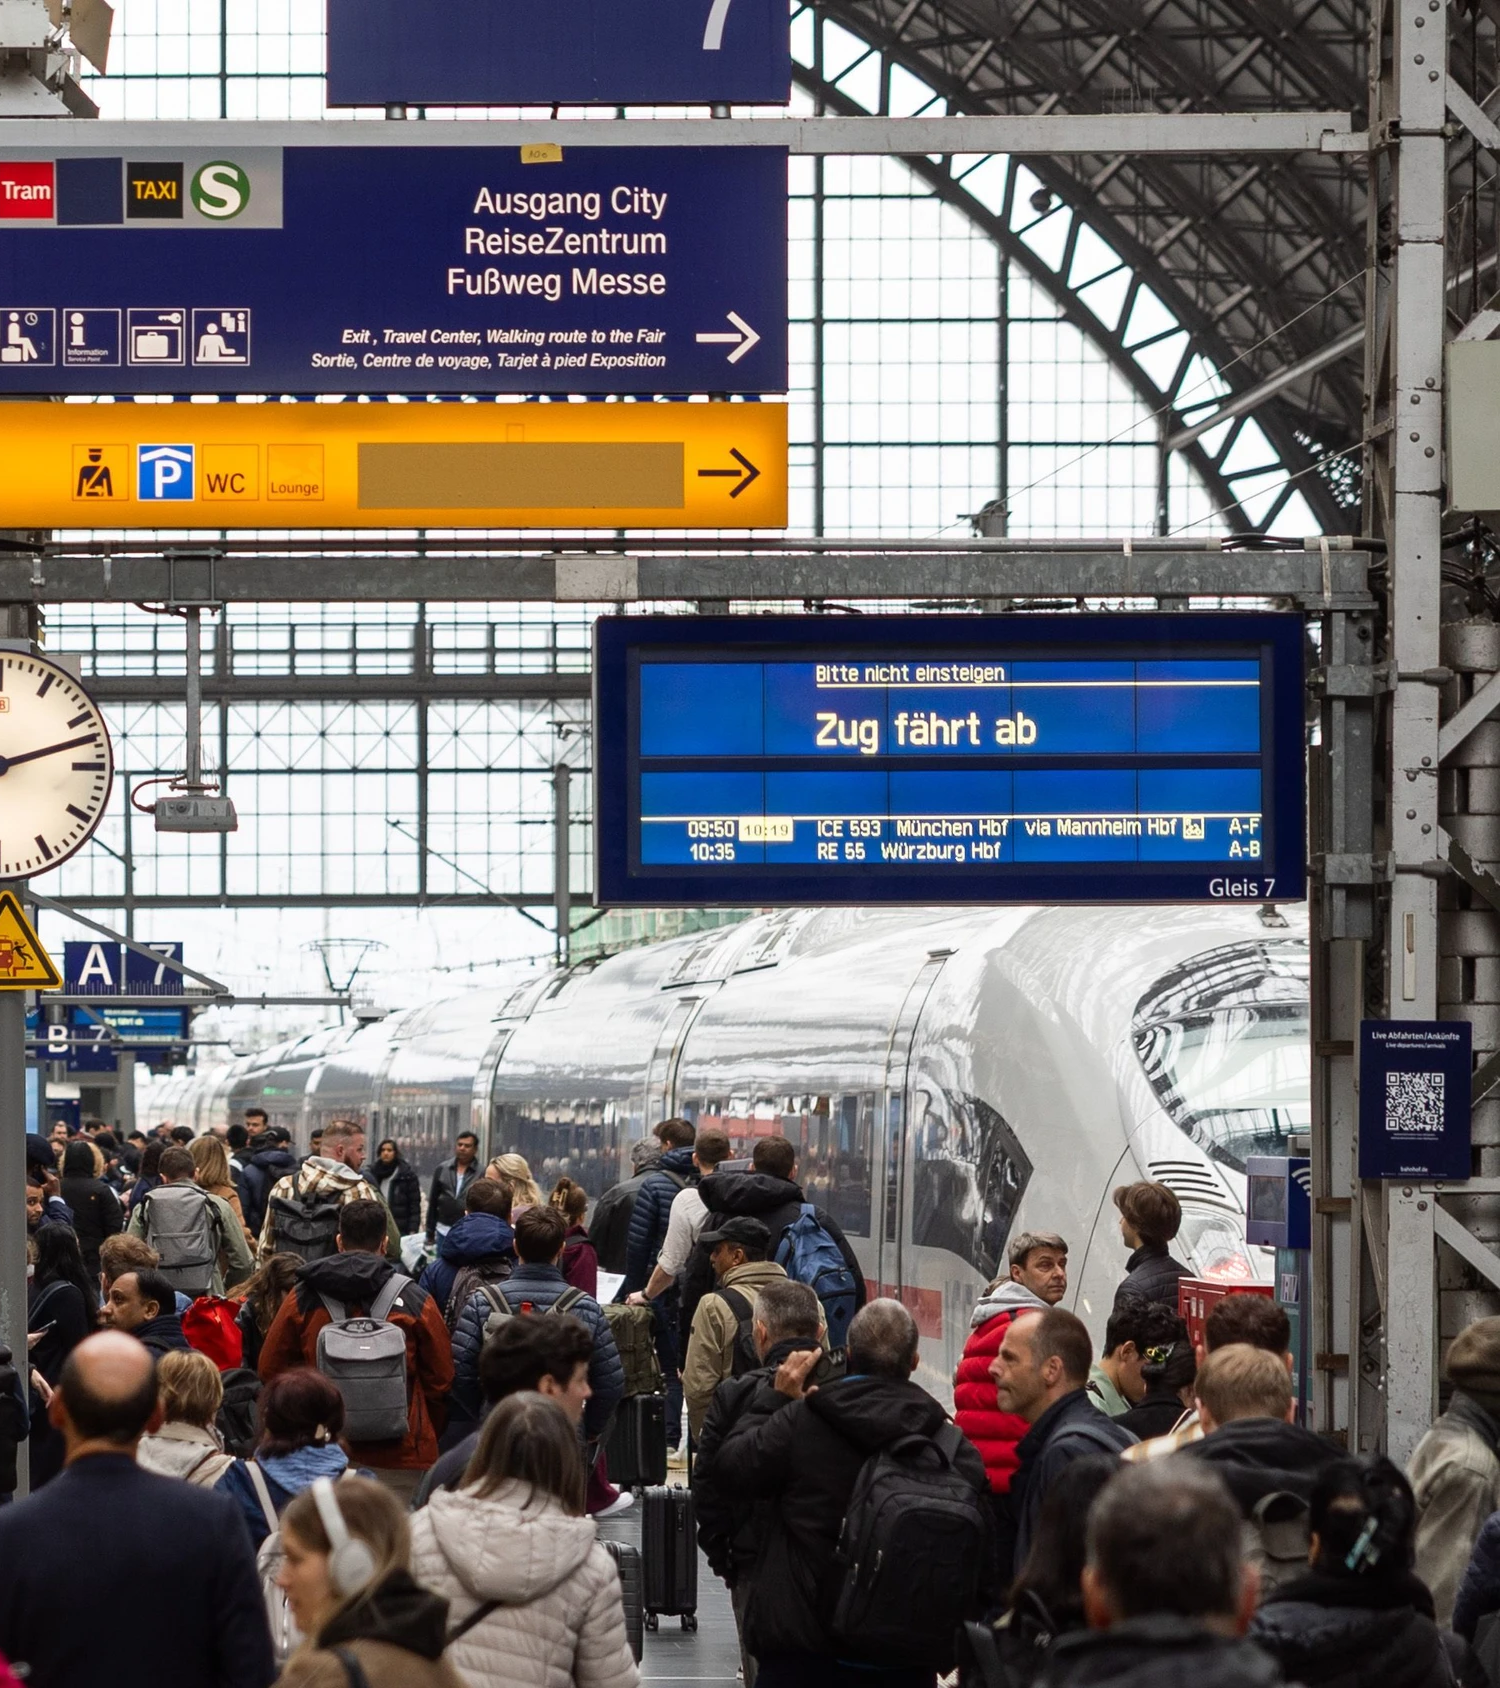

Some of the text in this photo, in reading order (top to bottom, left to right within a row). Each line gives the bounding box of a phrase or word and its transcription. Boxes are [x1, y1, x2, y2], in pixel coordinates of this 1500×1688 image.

[2, 181, 50, 199] Tram
[133, 181, 176, 199] TAXI
[199, 165, 241, 217] S
[474, 187, 667, 220] Ausgang City
[466, 228, 666, 254] ReiseZentrum
[449, 268, 665, 301] Fußweg Messe
[342, 330, 370, 343] Exit
[384, 330, 427, 343] Travel
[431, 329, 481, 345] Center,
[487, 329, 545, 346] Walking
[549, 330, 587, 343] route
[592, 330, 606, 343] to
[610, 329, 633, 343] the
[637, 329, 666, 343] Fair
[67, 348, 109, 356] Information
[312, 353, 666, 370] Sortie, Centre de voyage, Tarjet à pied Exposition
[154, 460, 183, 498] P
[207, 473, 244, 493] WC
[270, 482, 319, 498] Lounge
[816, 664, 1004, 682] Bitte nicht einsteigen
[816, 712, 1036, 754] Zug fährt ab
[687, 817, 1261, 838] 09:50 10:19 ICE 593 München Hbf via Mannheim Hbf A-F
[689, 840, 1261, 862] 10:35 RE 55 Würzburg Hbf A-B
[1210, 879, 1275, 896] Gleis 7
[78, 943, 177, 986] A 7
[48, 1025, 107, 1053] B 7
[1371, 1031, 1460, 1041] Live Abfahrten/Ankünfte
